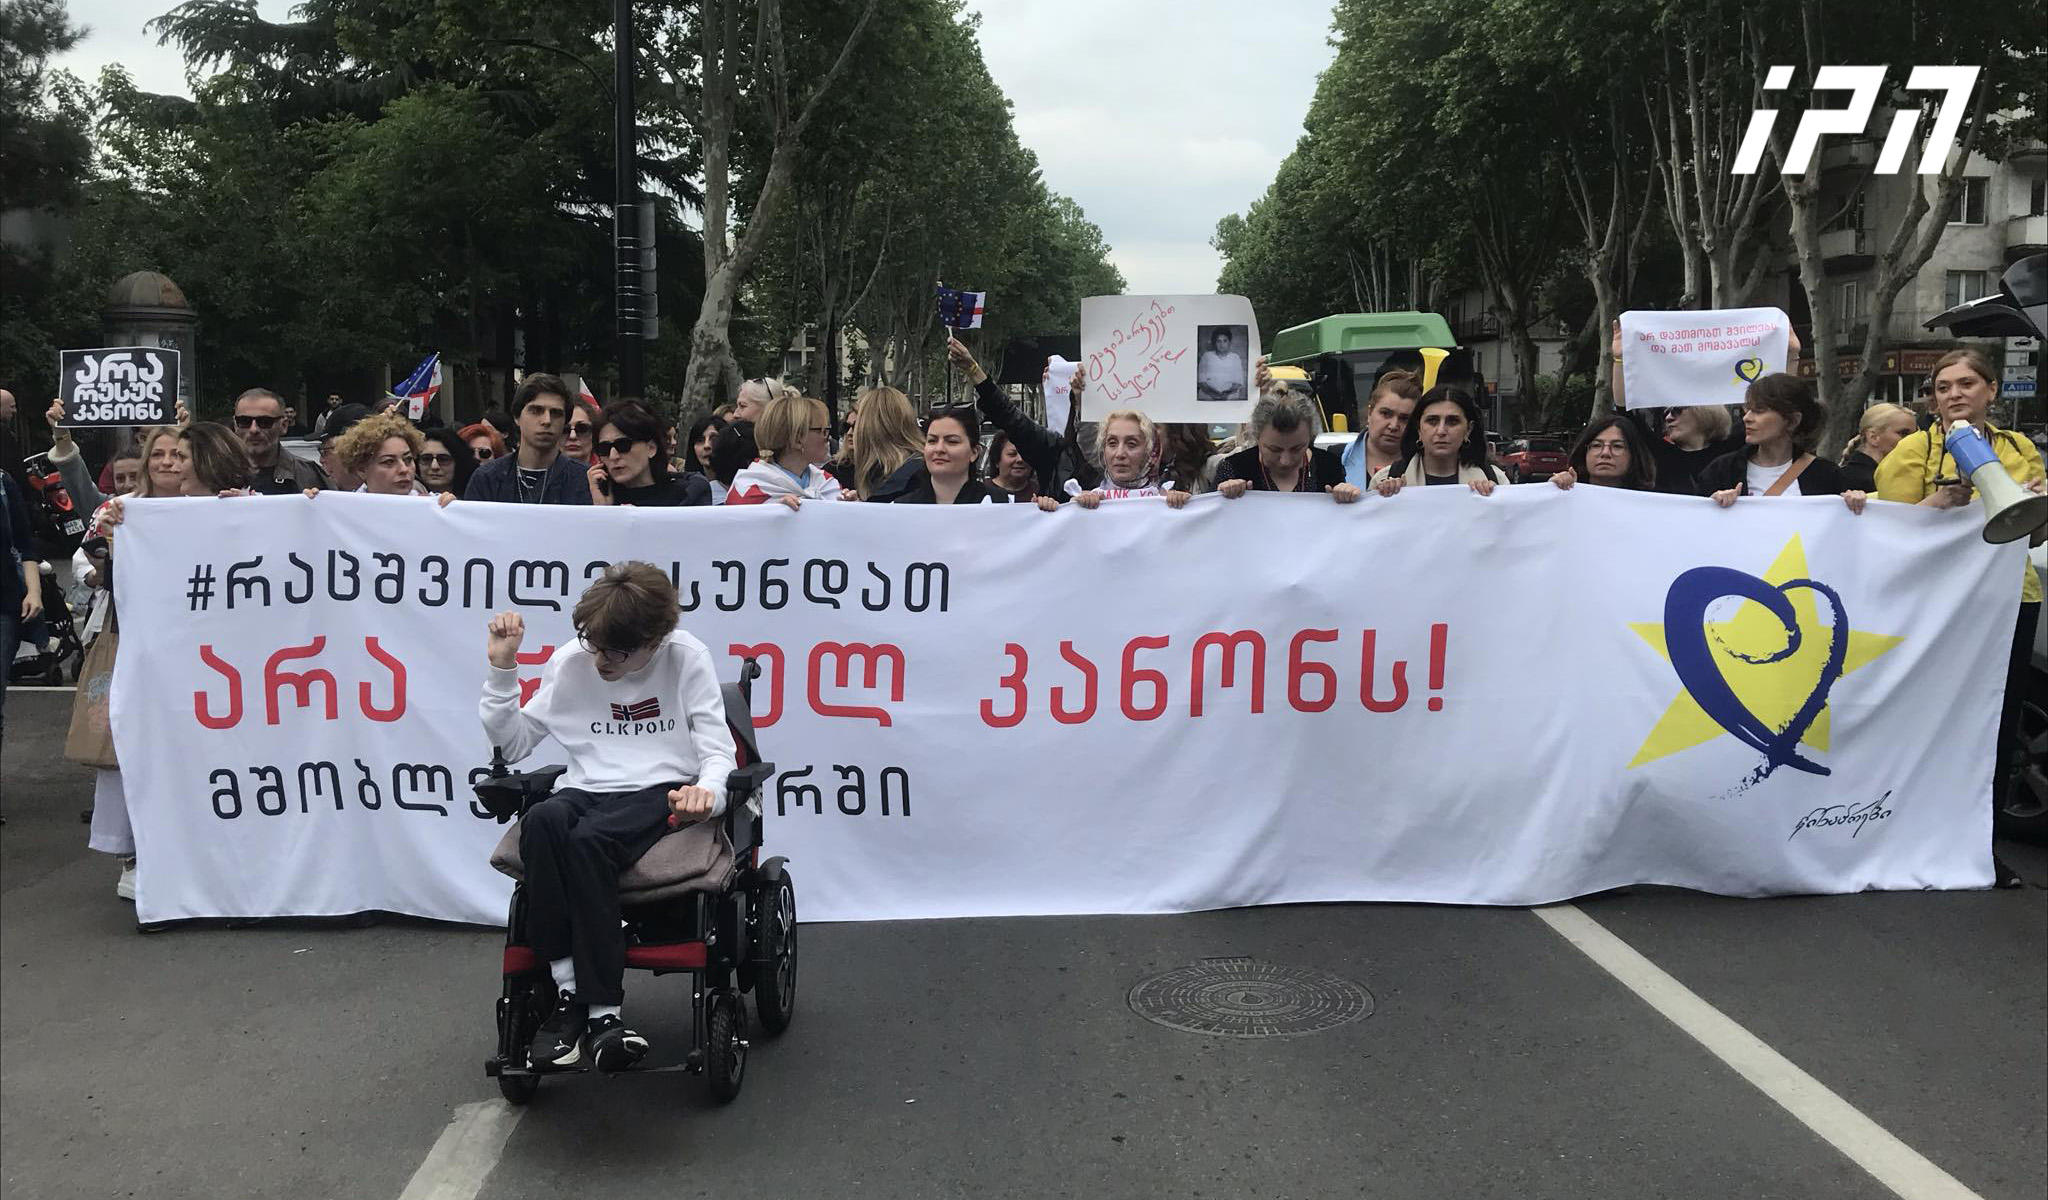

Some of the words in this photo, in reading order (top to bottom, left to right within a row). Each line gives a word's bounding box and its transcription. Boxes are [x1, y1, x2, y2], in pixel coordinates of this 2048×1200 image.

[1651, 344, 1666, 354] და
[1671, 343, 1693, 354] მათ
[75, 352, 164, 383] არა
[73, 381, 163, 403] რუსულ
[72, 402, 163, 422] კანონს
[187, 550, 950, 613] #რაცშვილსუნდათ
[194, 635, 407, 730] არა
[979, 623, 1448, 729] კანონს!
[210, 758, 512, 820] მშობლ
